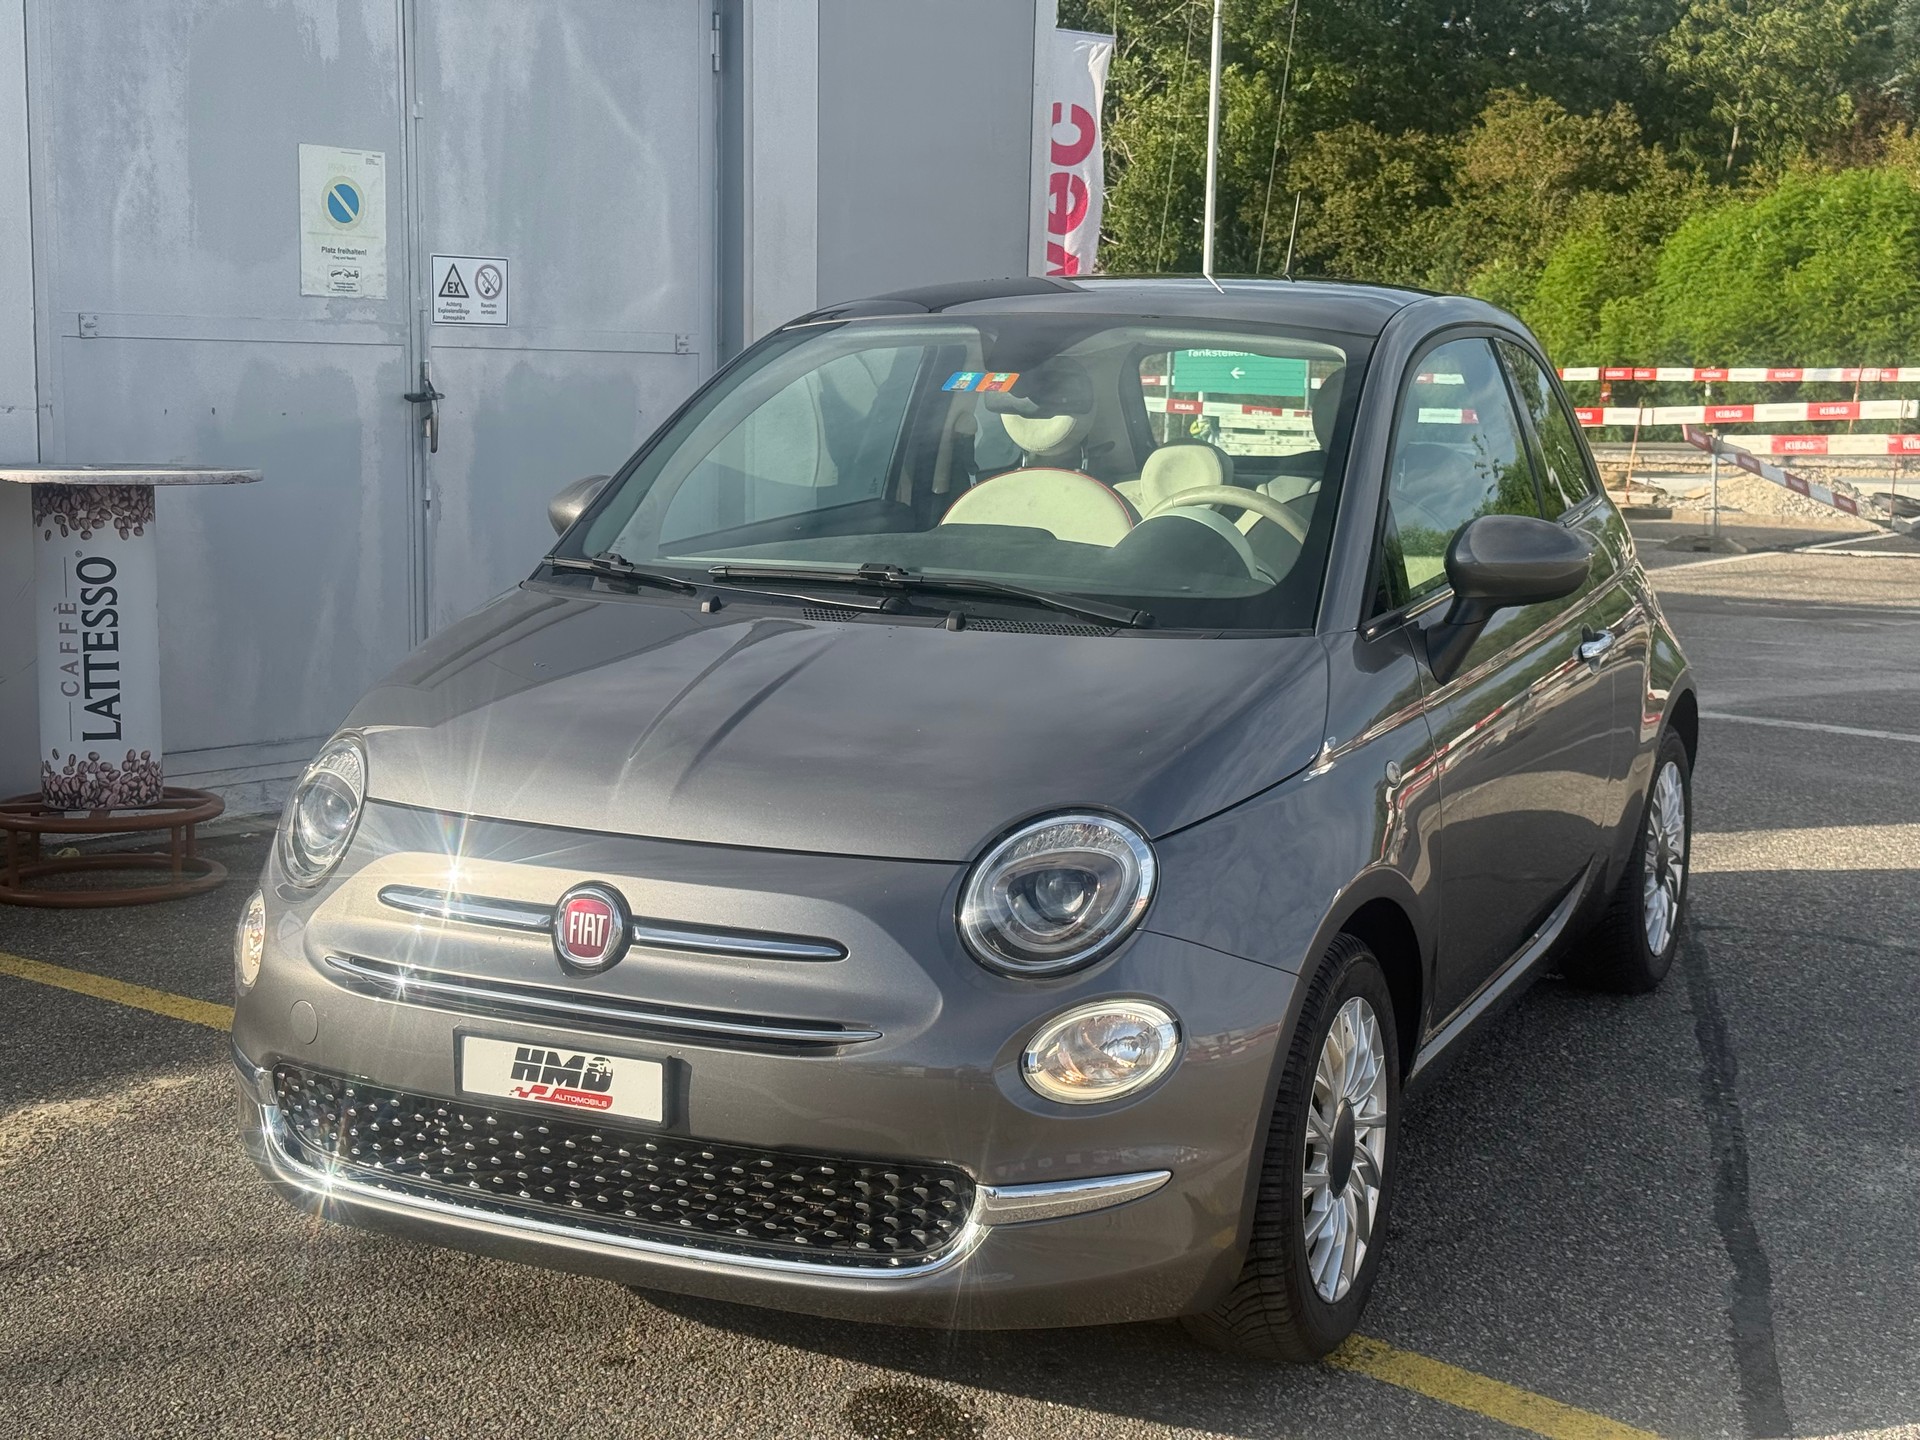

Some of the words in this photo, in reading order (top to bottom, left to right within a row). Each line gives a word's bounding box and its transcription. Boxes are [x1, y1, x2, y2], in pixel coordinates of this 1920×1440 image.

[321, 246, 336, 254] Platz
[337, 247, 367, 256] freihalten!
[447, 281, 460, 294] EX
[1715, 409, 1744, 419] KIBAG
[1819, 406, 1849, 416] KIBAG
[1784, 440, 1815, 450] KIBAG
[1902, 439, 1920, 450] KIB
[53, 602, 80, 697] CAFFÈ
[76, 556, 121, 742] LATTESSO
[569, 911, 608, 947] FIAT
[554, 1093, 608, 1108] AUTOMOBILE
